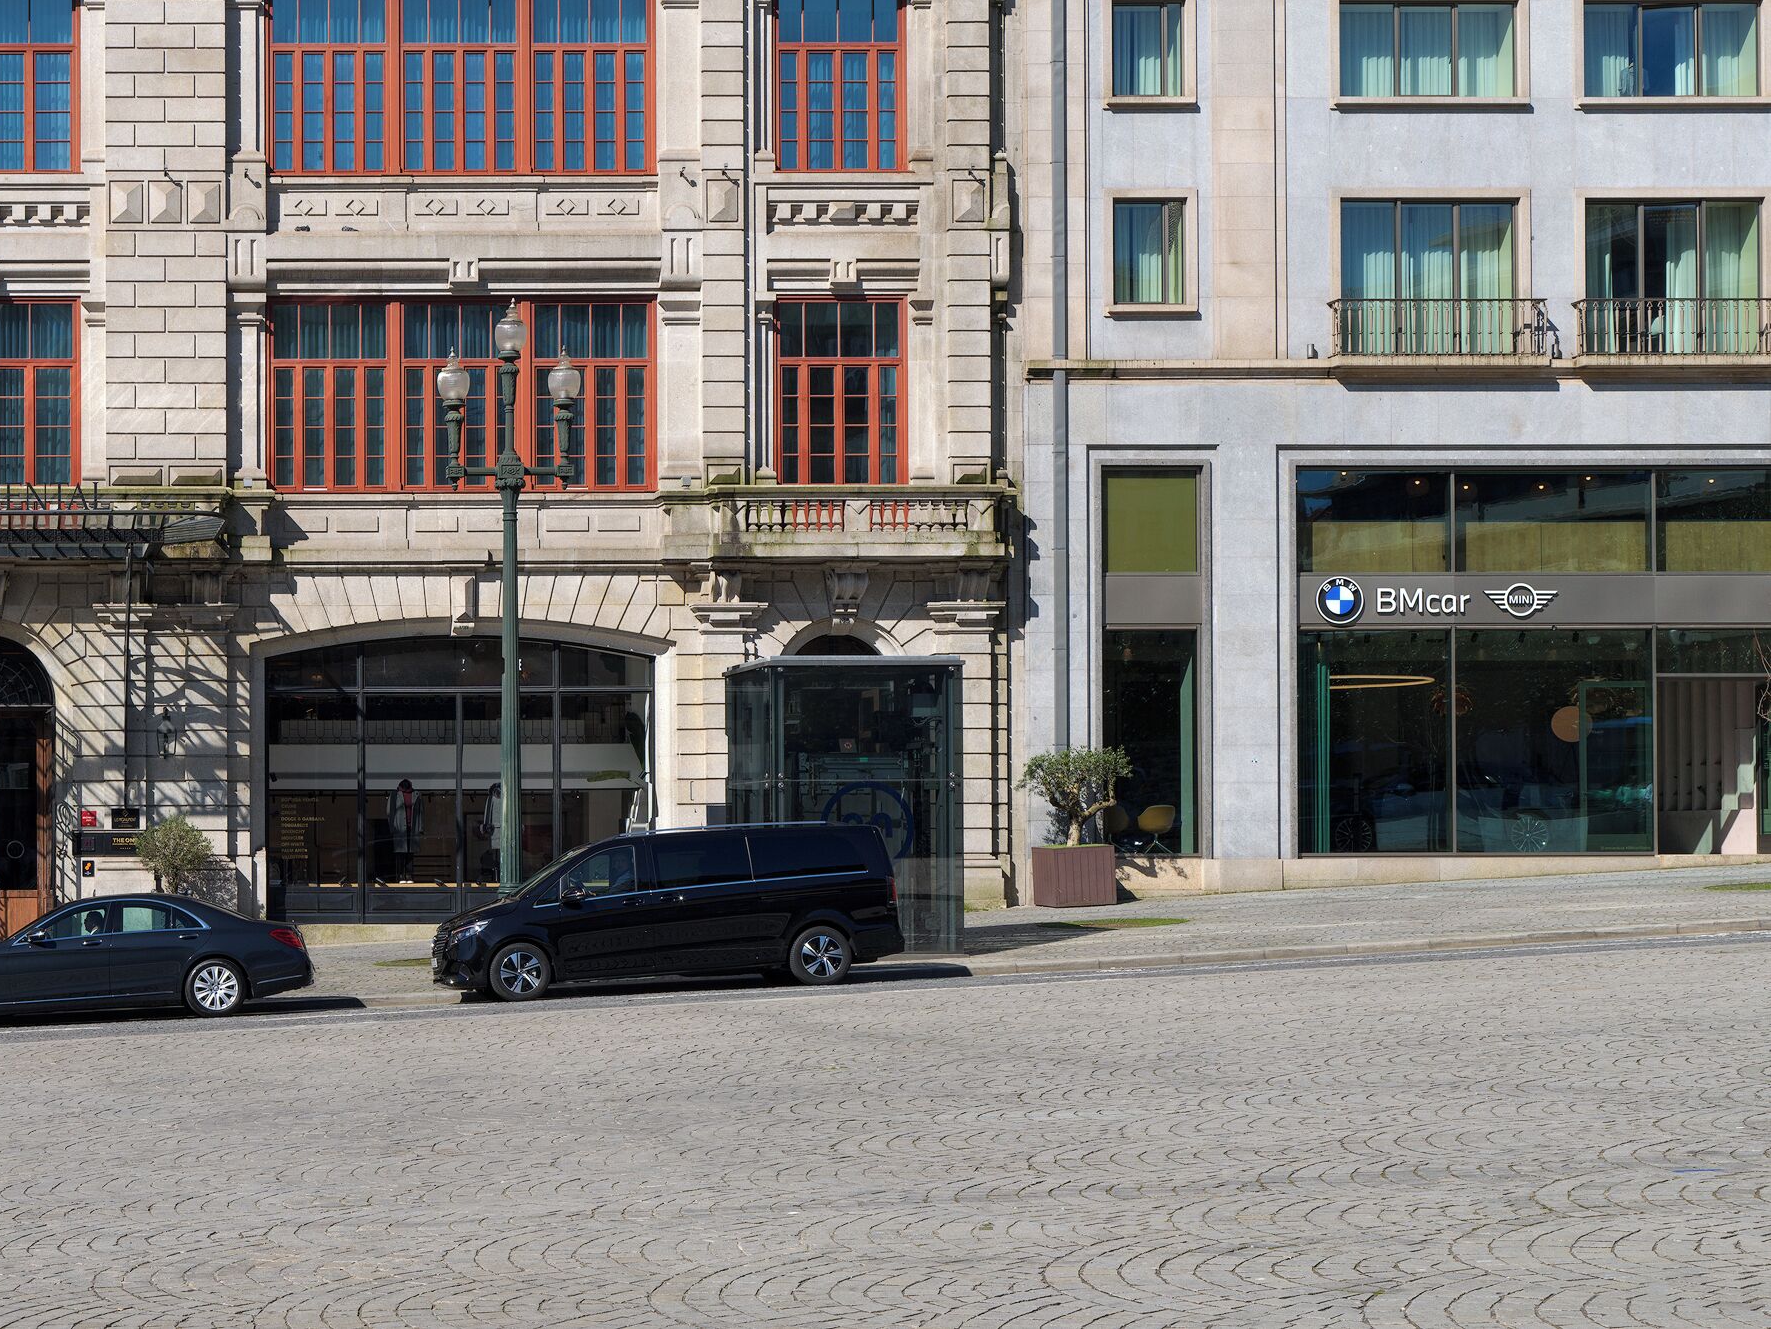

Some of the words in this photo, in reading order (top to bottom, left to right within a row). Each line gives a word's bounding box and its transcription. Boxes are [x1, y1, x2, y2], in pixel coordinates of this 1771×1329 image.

[1323, 578, 1358, 593] BMW
[1377, 587, 1471, 613] BMcar
[1508, 595, 1534, 605] MINI
